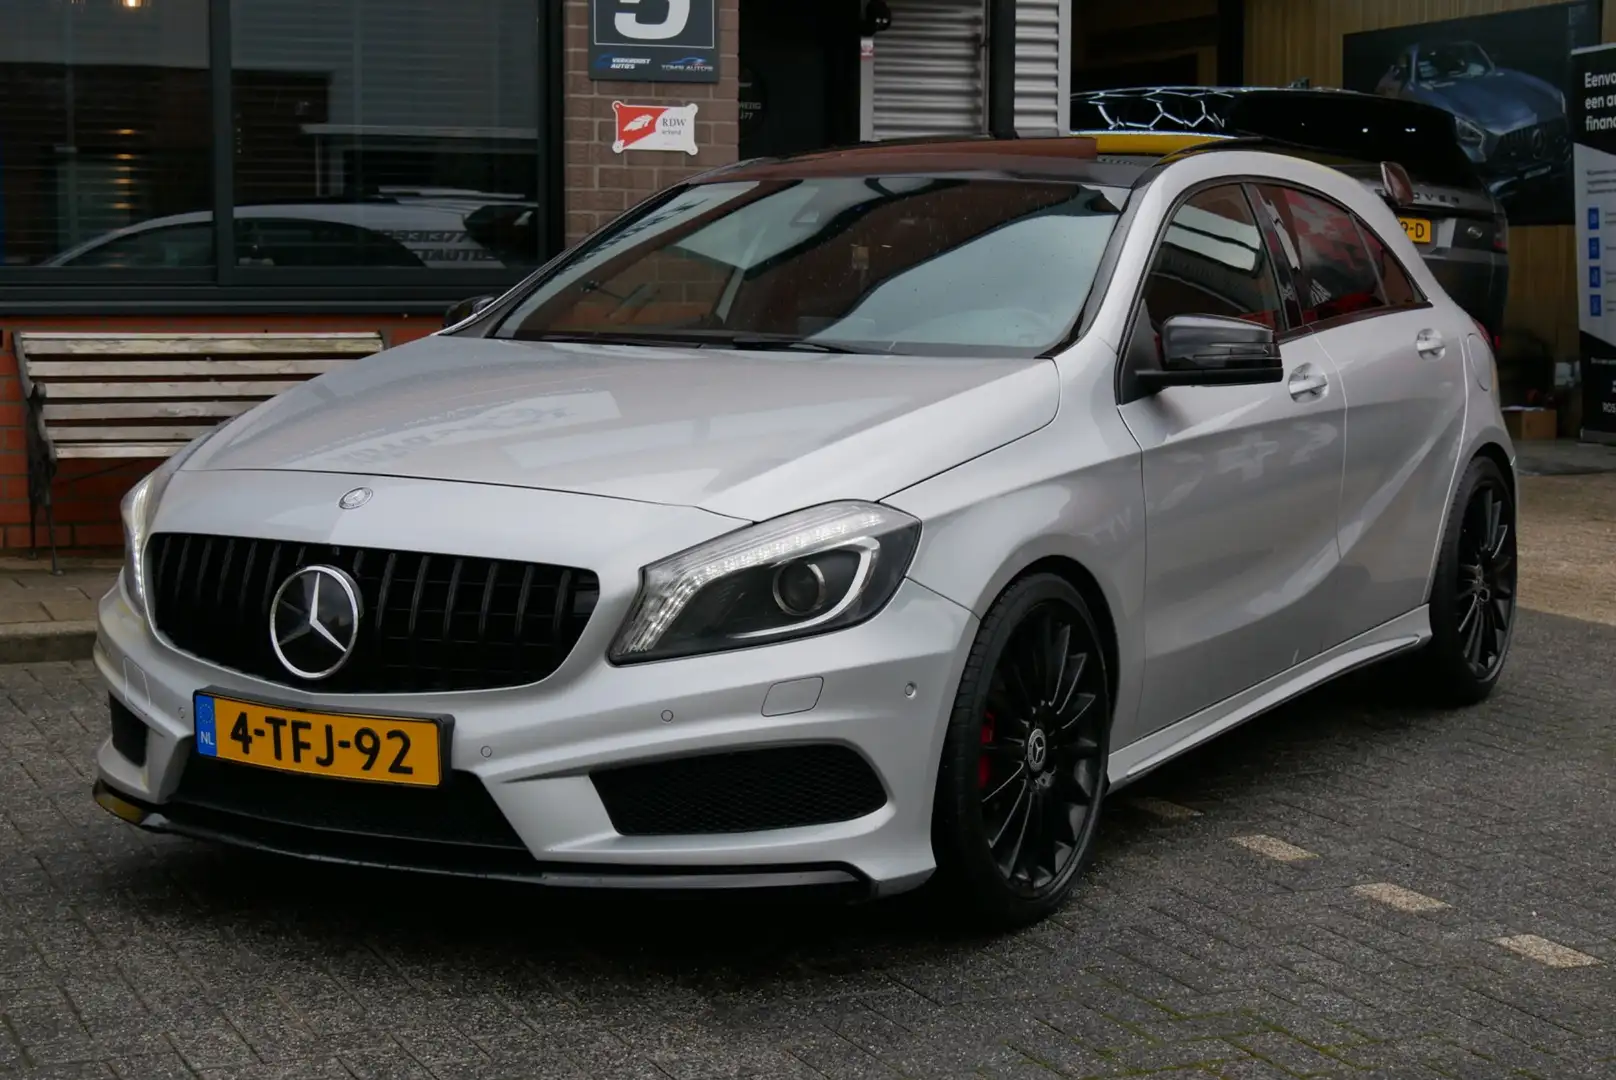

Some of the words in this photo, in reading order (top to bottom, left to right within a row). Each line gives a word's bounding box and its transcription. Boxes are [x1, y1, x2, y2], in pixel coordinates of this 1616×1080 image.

[1585, 96, 1604, 110] een
[662, 118, 687, 127] RDW
[1413, 191, 1460, 204] OVER
[200, 731, 215, 746] NL
[230, 711, 414, 775] 4-TFJ-92
